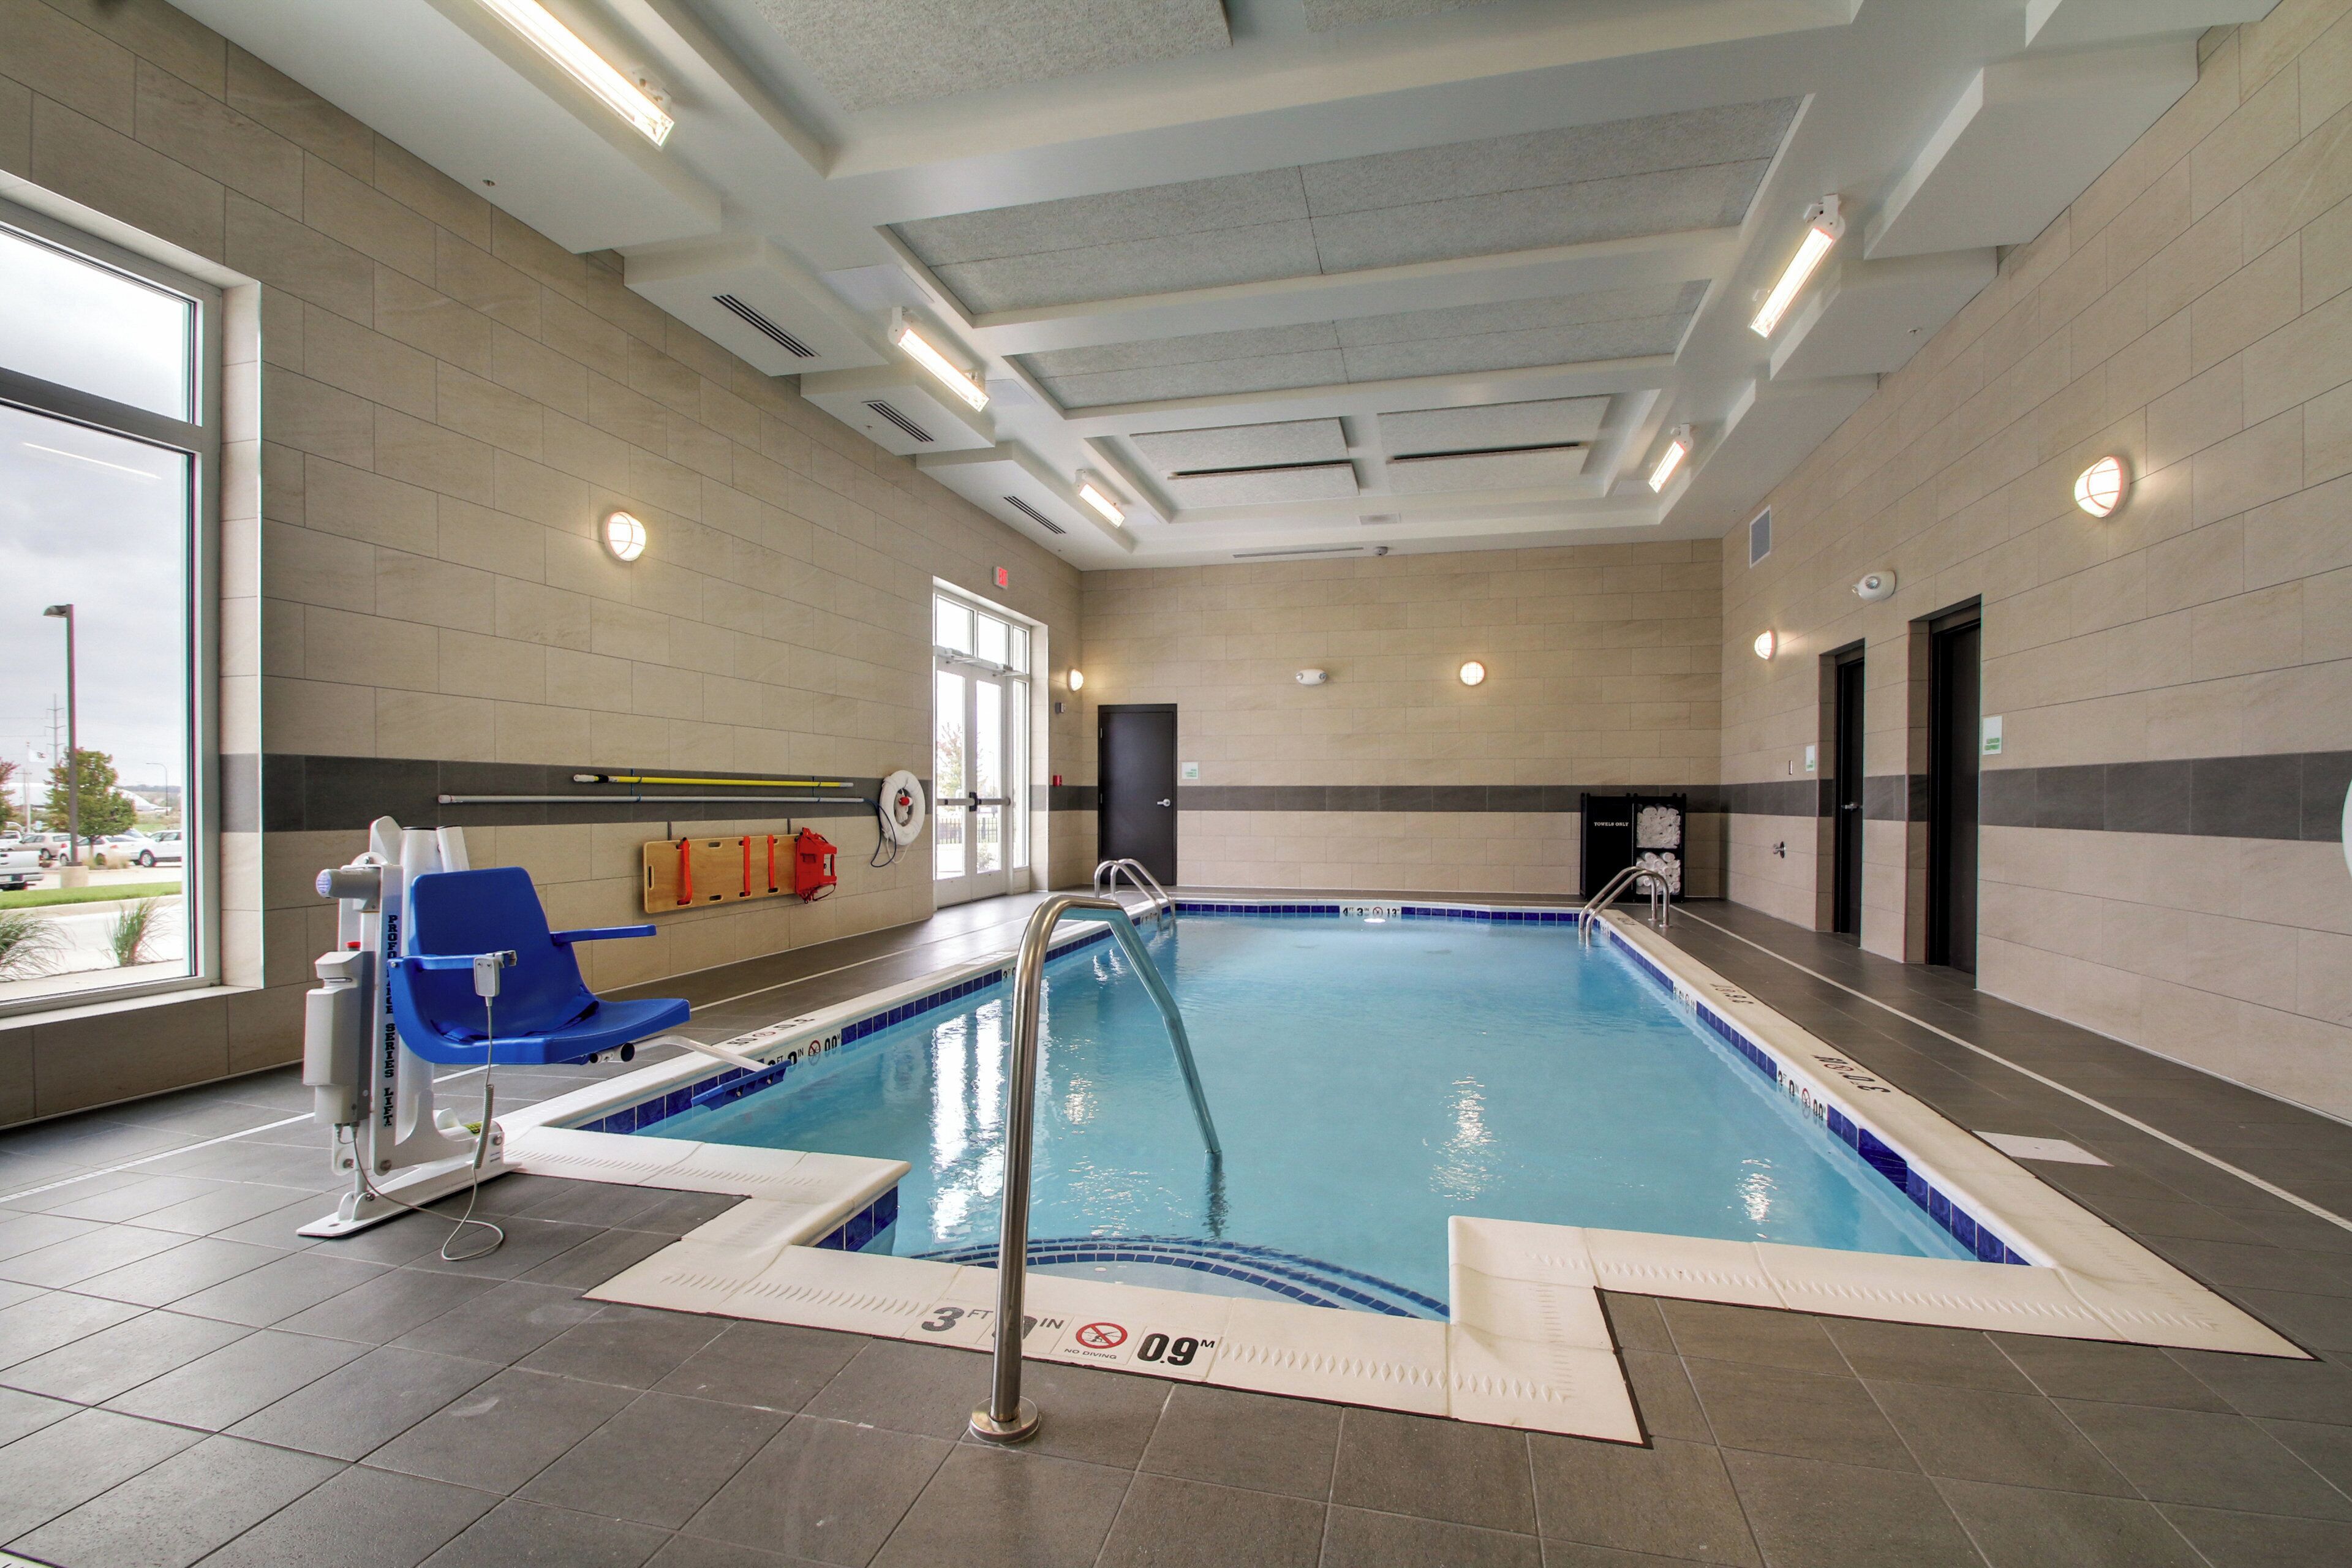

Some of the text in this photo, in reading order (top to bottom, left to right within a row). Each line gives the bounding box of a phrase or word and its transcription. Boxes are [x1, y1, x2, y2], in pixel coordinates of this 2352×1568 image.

[385, 1023, 396, 1078] SERIES
[797, 1048, 804, 1058] IN
[383, 1087, 394, 1125] LIFT
[921, 1306, 965, 1332] 3
[967, 1309, 993, 1319] FT
[1039, 1318, 1064, 1330] IN
[1082, 1351, 1117, 1359] DIVING
